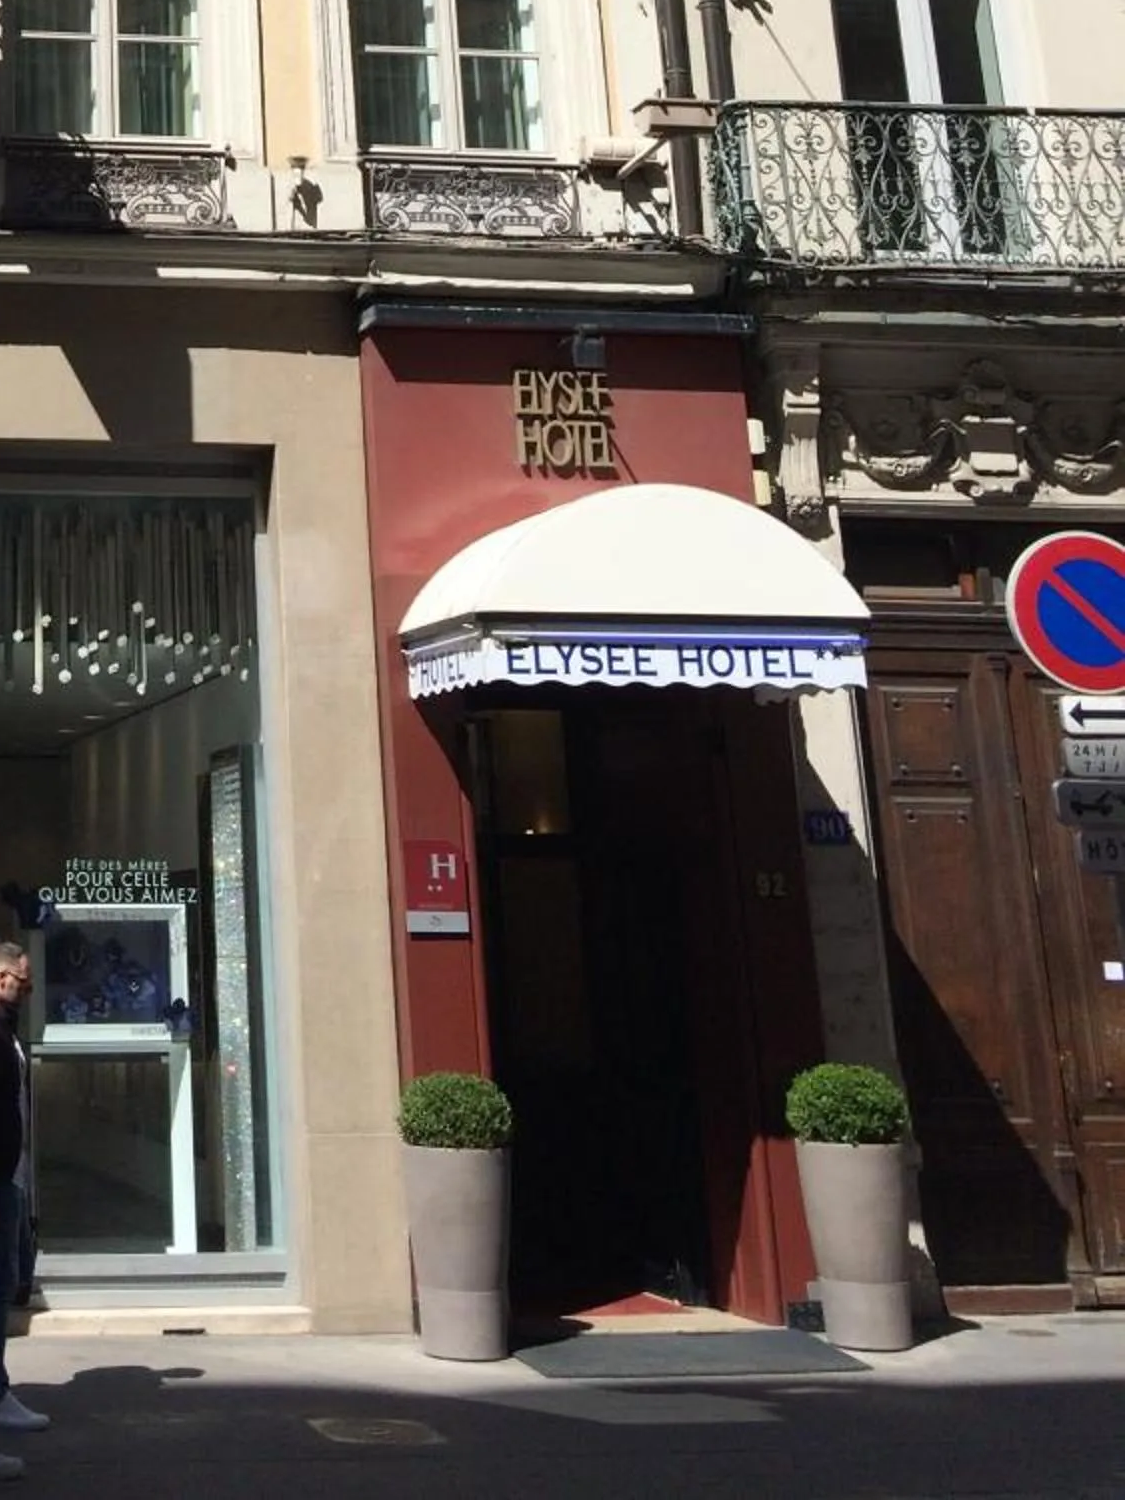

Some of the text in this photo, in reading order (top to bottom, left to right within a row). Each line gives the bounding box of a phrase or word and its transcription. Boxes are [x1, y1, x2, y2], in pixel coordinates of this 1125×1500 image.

[513, 369, 611, 417] ELYSEE
[516, 419, 616, 468] HOTEL
[420, 651, 465, 688] HOTEL
[506, 644, 813, 679] ELYSEE HOTEL
[65, 871, 169, 887] POUR CELLE
[99, 860, 122, 870] DES
[430, 853, 457, 879] H
[38, 887, 198, 904] QUE VOUS AIMEZ
